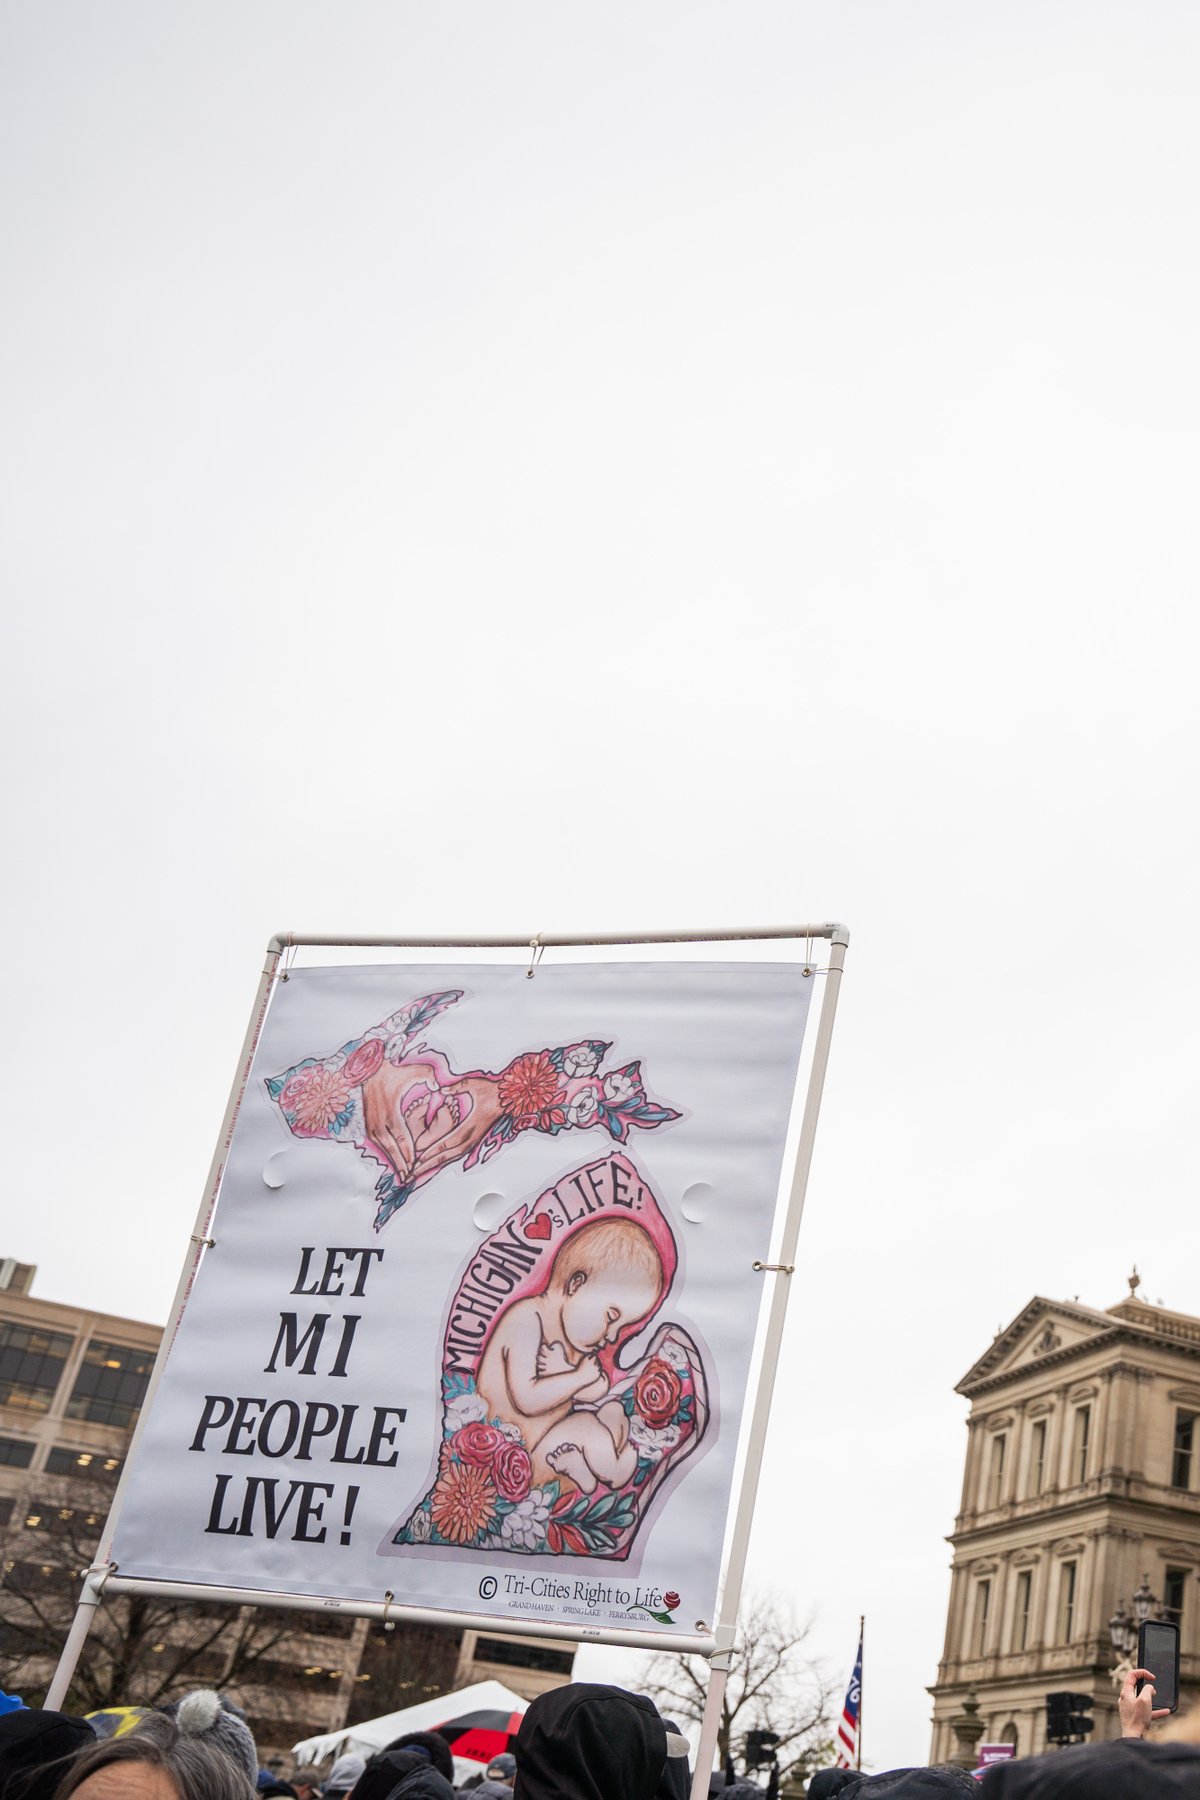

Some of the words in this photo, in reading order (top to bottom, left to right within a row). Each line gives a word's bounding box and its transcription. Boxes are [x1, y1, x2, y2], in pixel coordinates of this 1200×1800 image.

[290, 1247, 384, 1297] LET
[445, 1220, 543, 1375] MICHIGAN
[552, 1160, 643, 1226] LIFE!
[263, 1312, 361, 1377] MI
[189, 1395, 407, 1467] PEOPLE
[204, 1474, 360, 1545] LIVE!
[504, 1574, 570, 1600] Tri-Cities
[573, 1581, 612, 1608] Right
[615, 1589, 631, 1605] to
[634, 1587, 662, 1608] Life
[508, 1600, 531, 1609] GRAND
[531, 1603, 554, 1612] HAVEN
[561, 1605, 584, 1615] SPRING
[584, 1608, 601, 1617] LAKE
[608, 1610, 650, 1622] FERRYSBURG
